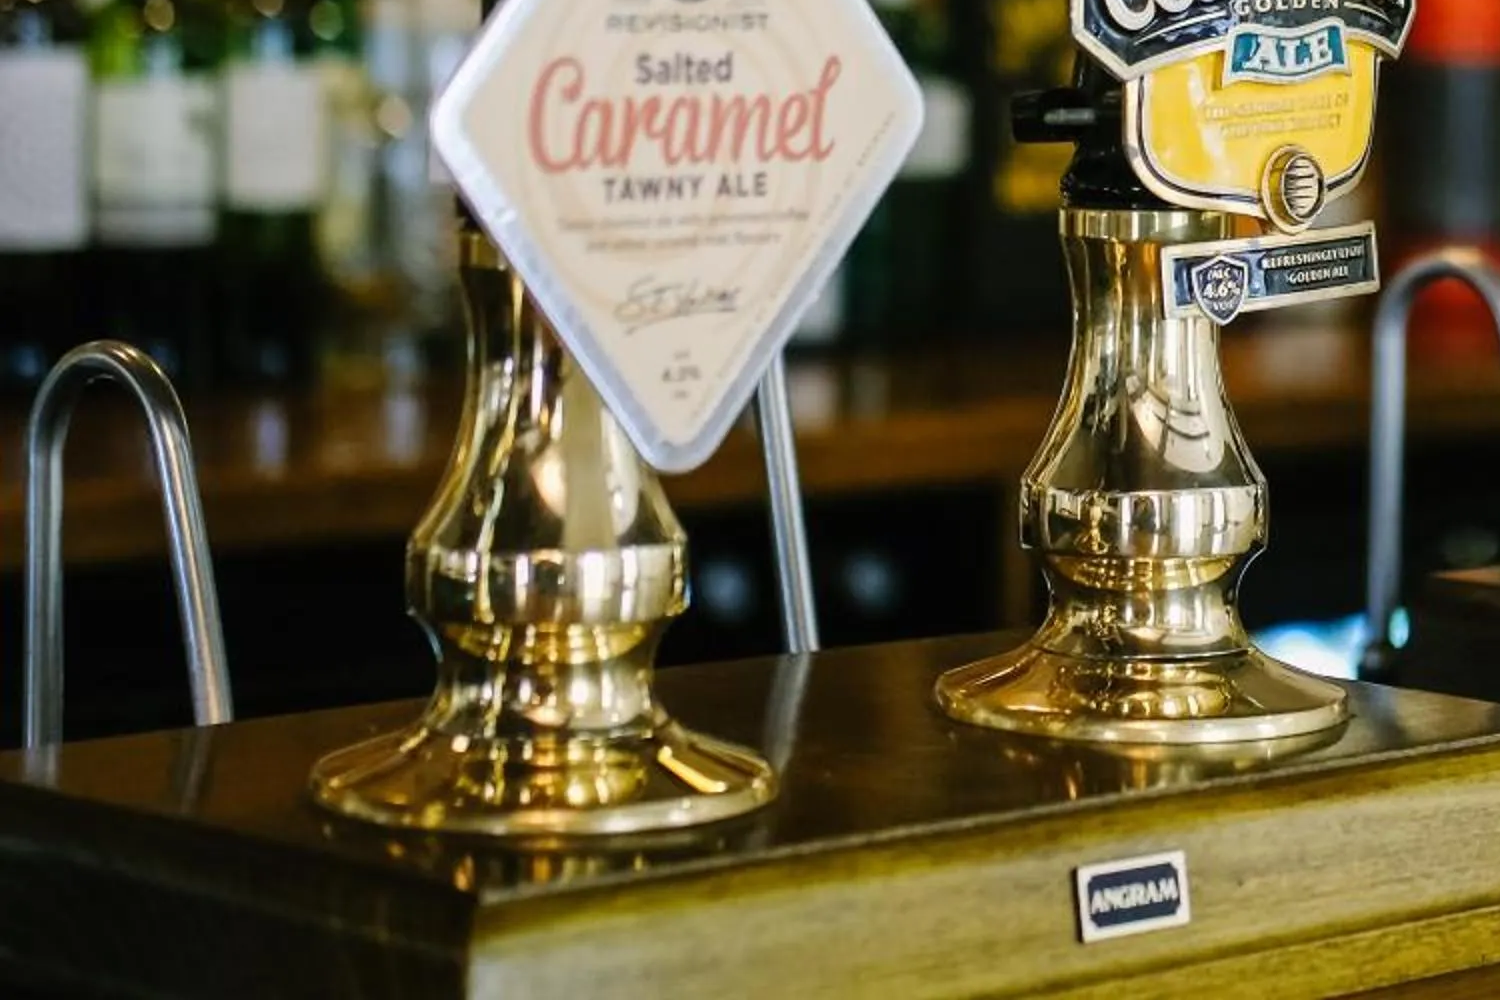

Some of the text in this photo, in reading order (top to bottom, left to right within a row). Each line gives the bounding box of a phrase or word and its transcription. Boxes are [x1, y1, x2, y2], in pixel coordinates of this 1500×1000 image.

[636, 51, 734, 85] Salted
[1241, 28, 1334, 75] ALE
[528, 55, 841, 174] Caramel
[603, 172, 769, 205] TAWNY ALE
